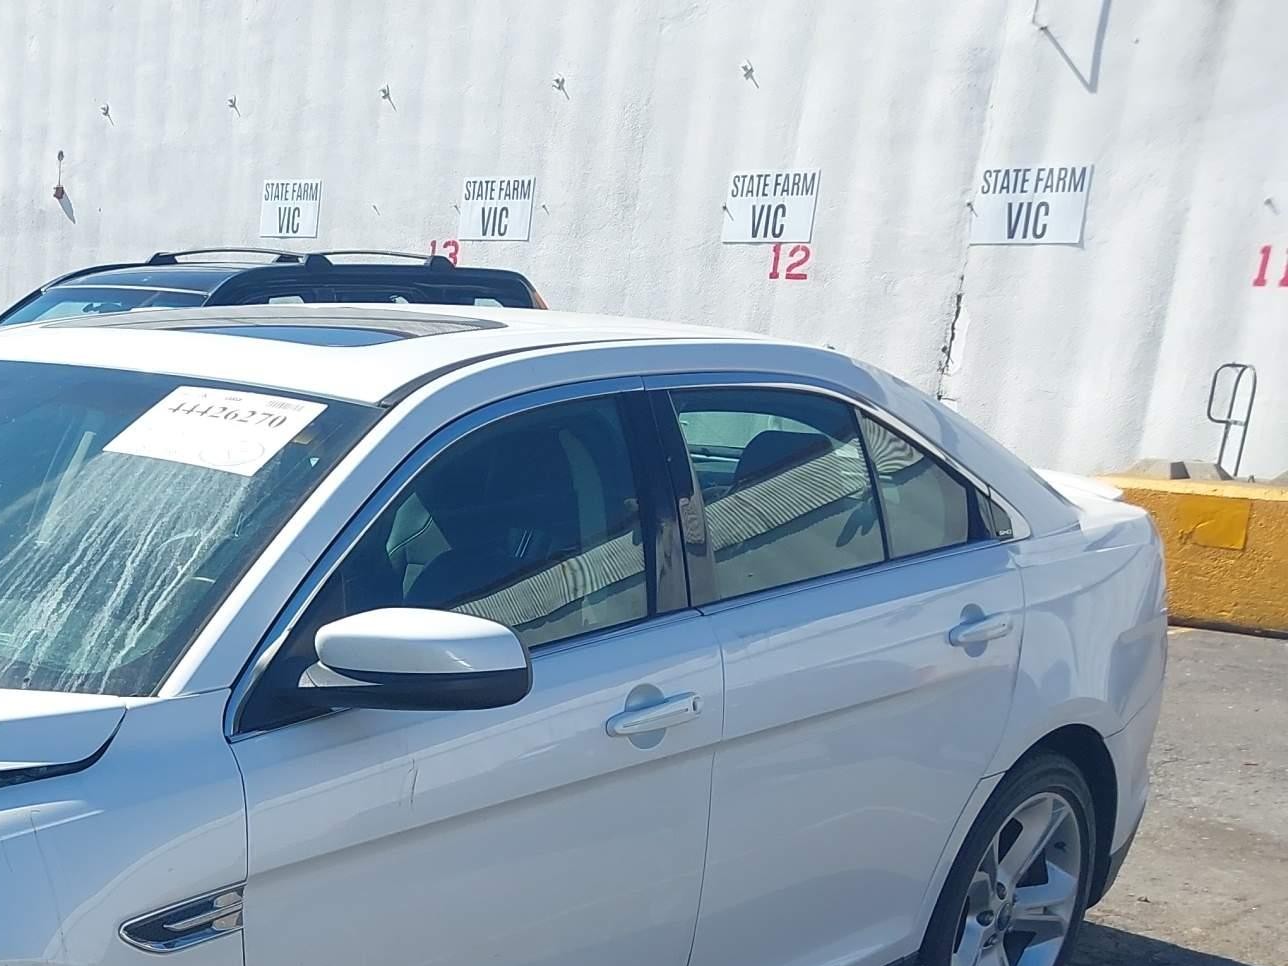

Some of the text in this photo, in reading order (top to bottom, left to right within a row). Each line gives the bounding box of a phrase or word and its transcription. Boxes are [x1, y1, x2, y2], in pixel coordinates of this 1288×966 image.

[264, 182, 318, 201] STATE FARM
[464, 179, 532, 201] STATE FARM
[732, 173, 816, 198] STATE FARM
[981, 166, 1086, 195] STATE FARM
[278, 207, 301, 234] VIC
[481, 206, 509, 237] VIC
[751, 204, 786, 239] VIC
[1005, 202, 1050, 240] VIC
[769, 243, 811, 280] 12
[168, 402, 287, 428] 44426270
